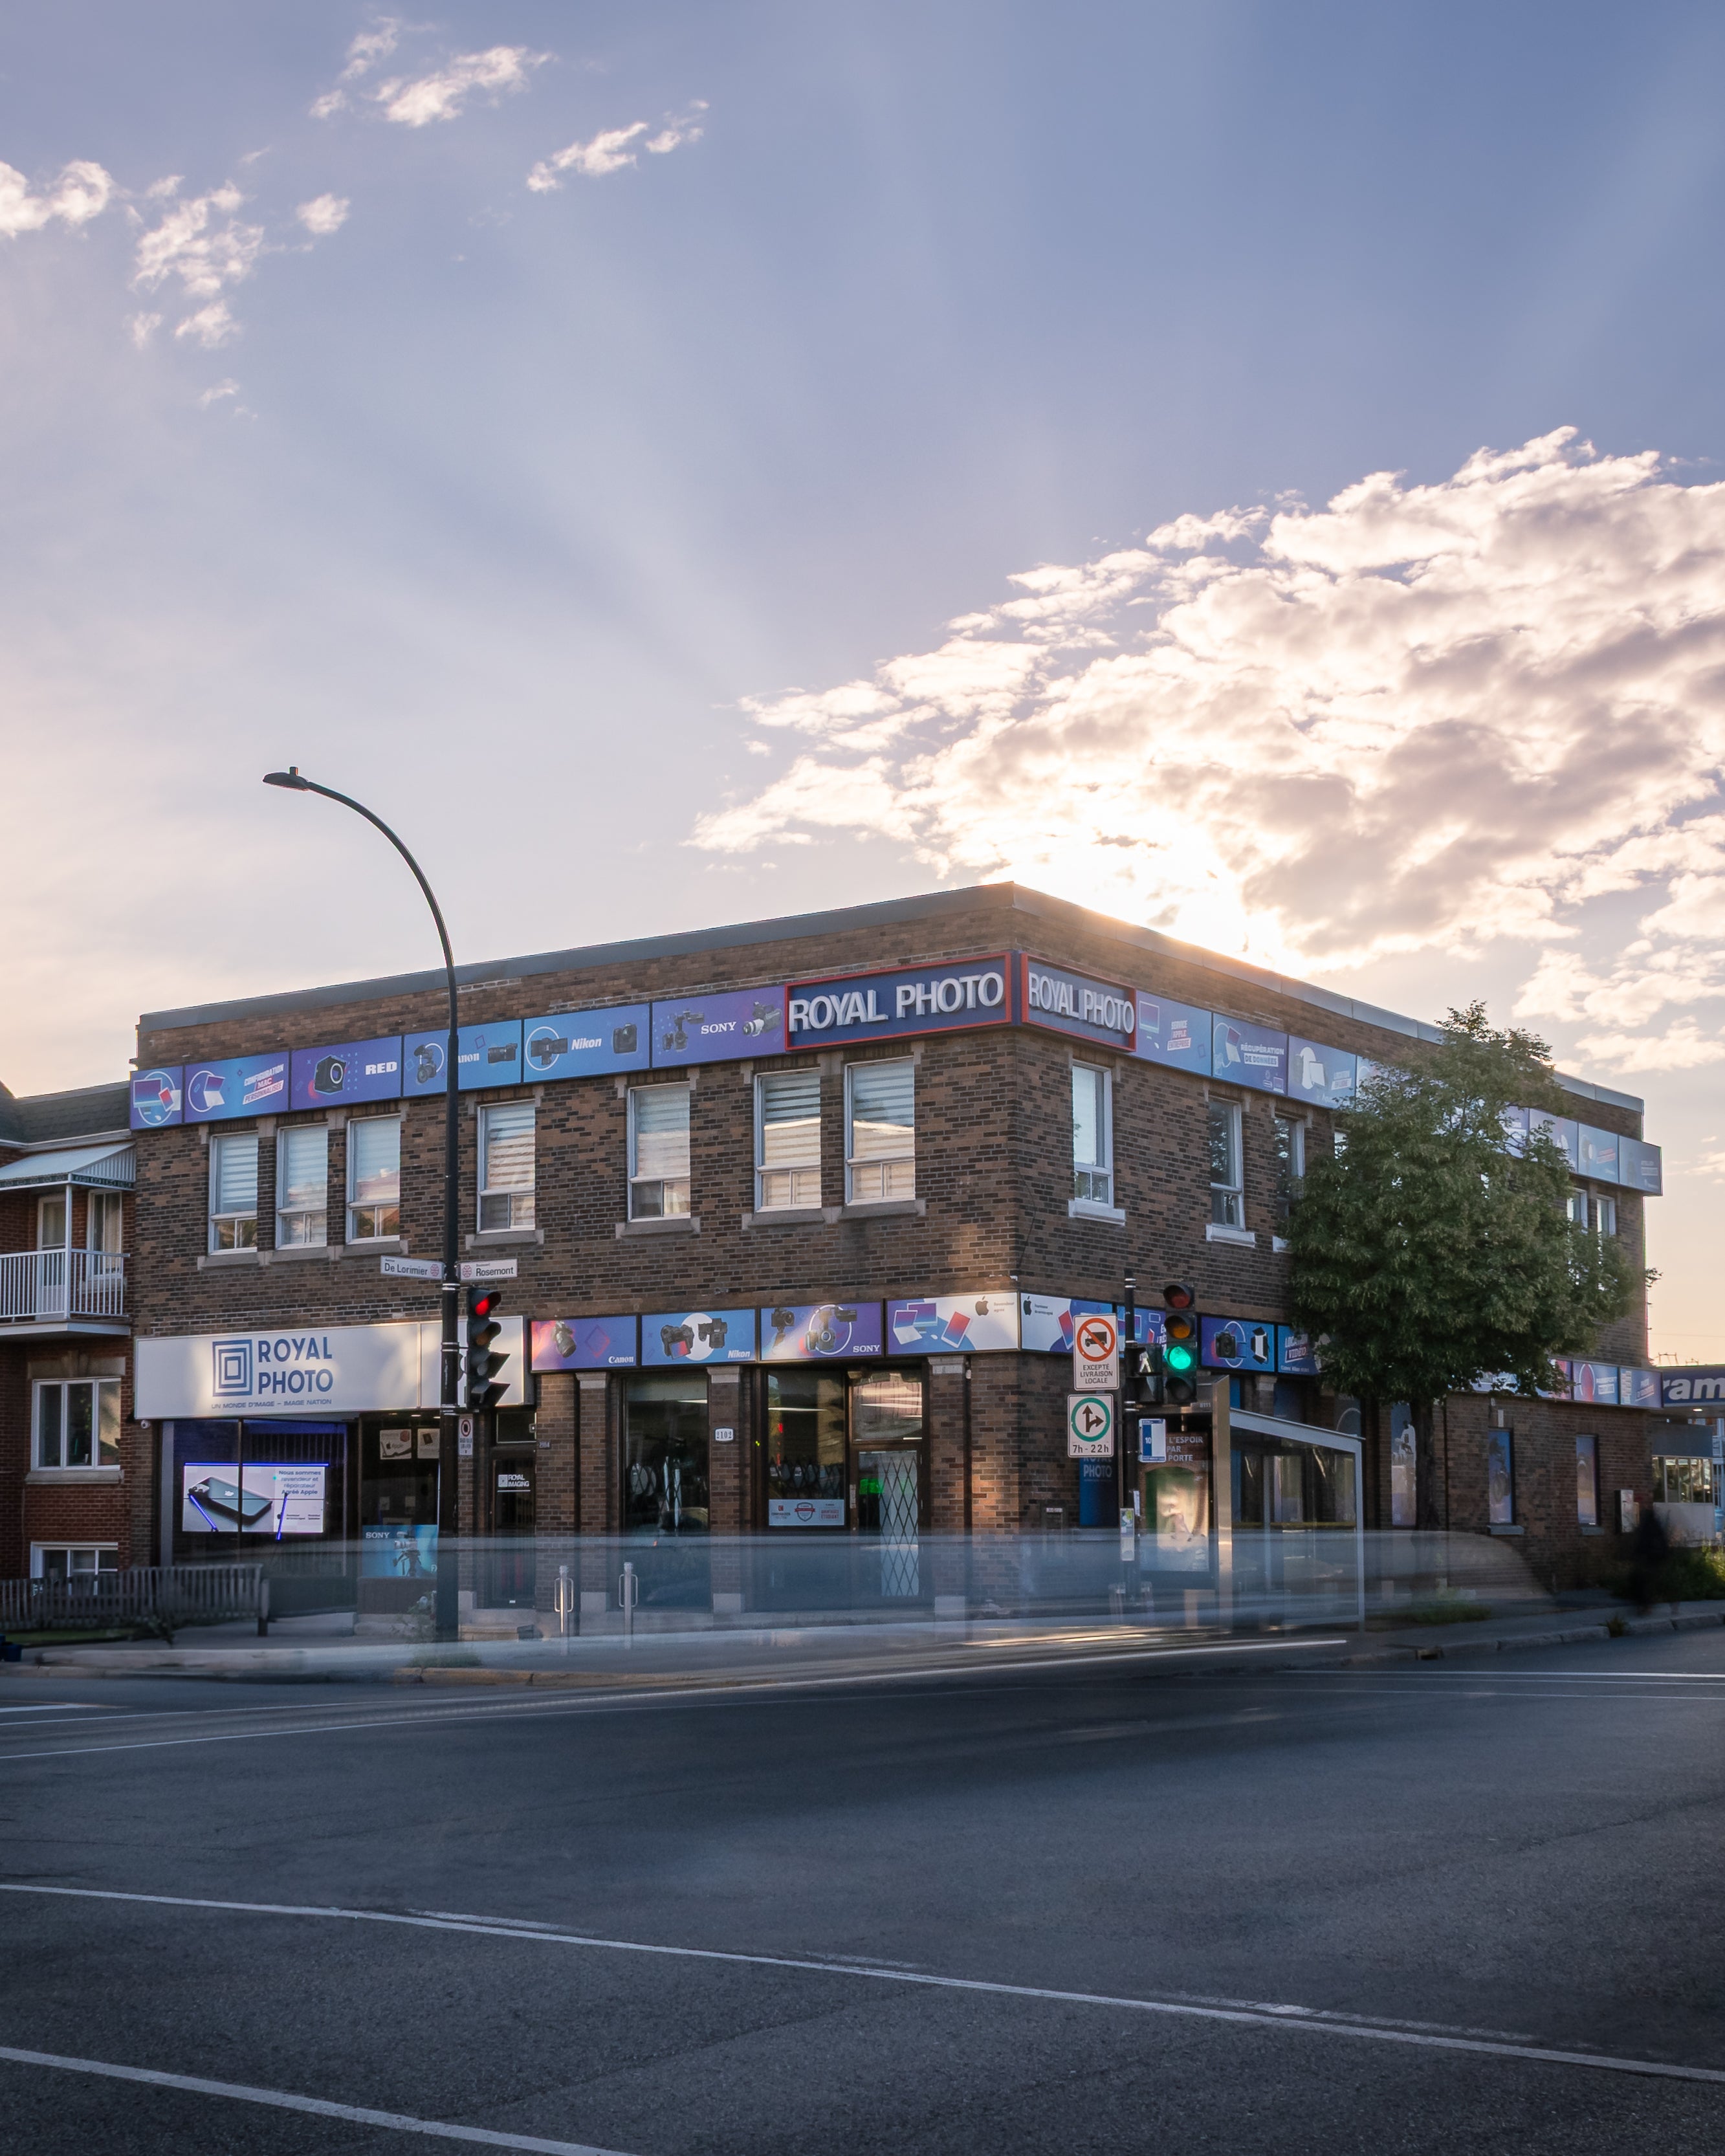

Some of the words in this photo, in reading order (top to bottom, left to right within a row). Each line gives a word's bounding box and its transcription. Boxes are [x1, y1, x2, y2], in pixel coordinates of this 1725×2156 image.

[789, 989, 889, 1033] ROYAL
[896, 972, 1004, 1018] PHOTO
[1028, 971, 1080, 1018] ROYAL
[1079, 989, 1135, 1035] PHOTO
[701, 1021, 737, 1035] SONY
[571, 1037, 602, 1050] Nikon
[1240, 1042, 1284, 1055] RÉCUPÉRATION
[458, 1053, 479, 1063] anon
[365, 1061, 397, 1075] RED
[257, 1077, 273, 1090] MAC
[384, 1262, 395, 1272] De
[397, 1264, 428, 1275] Lorimier
[476, 1267, 514, 1277] Rosemont
[258, 1336, 333, 1363] ROYAL
[728, 1349, 751, 1359] Nikon
[853, 1345, 880, 1353] SONY
[608, 1356, 634, 1364] Canon
[258, 1369, 333, 1394] PHOTO
[1072, 1444, 1083, 1453] 7h
[1090, 1444, 1109, 1453] 22h
[1083, 1464, 1112, 1477] PHOTO
